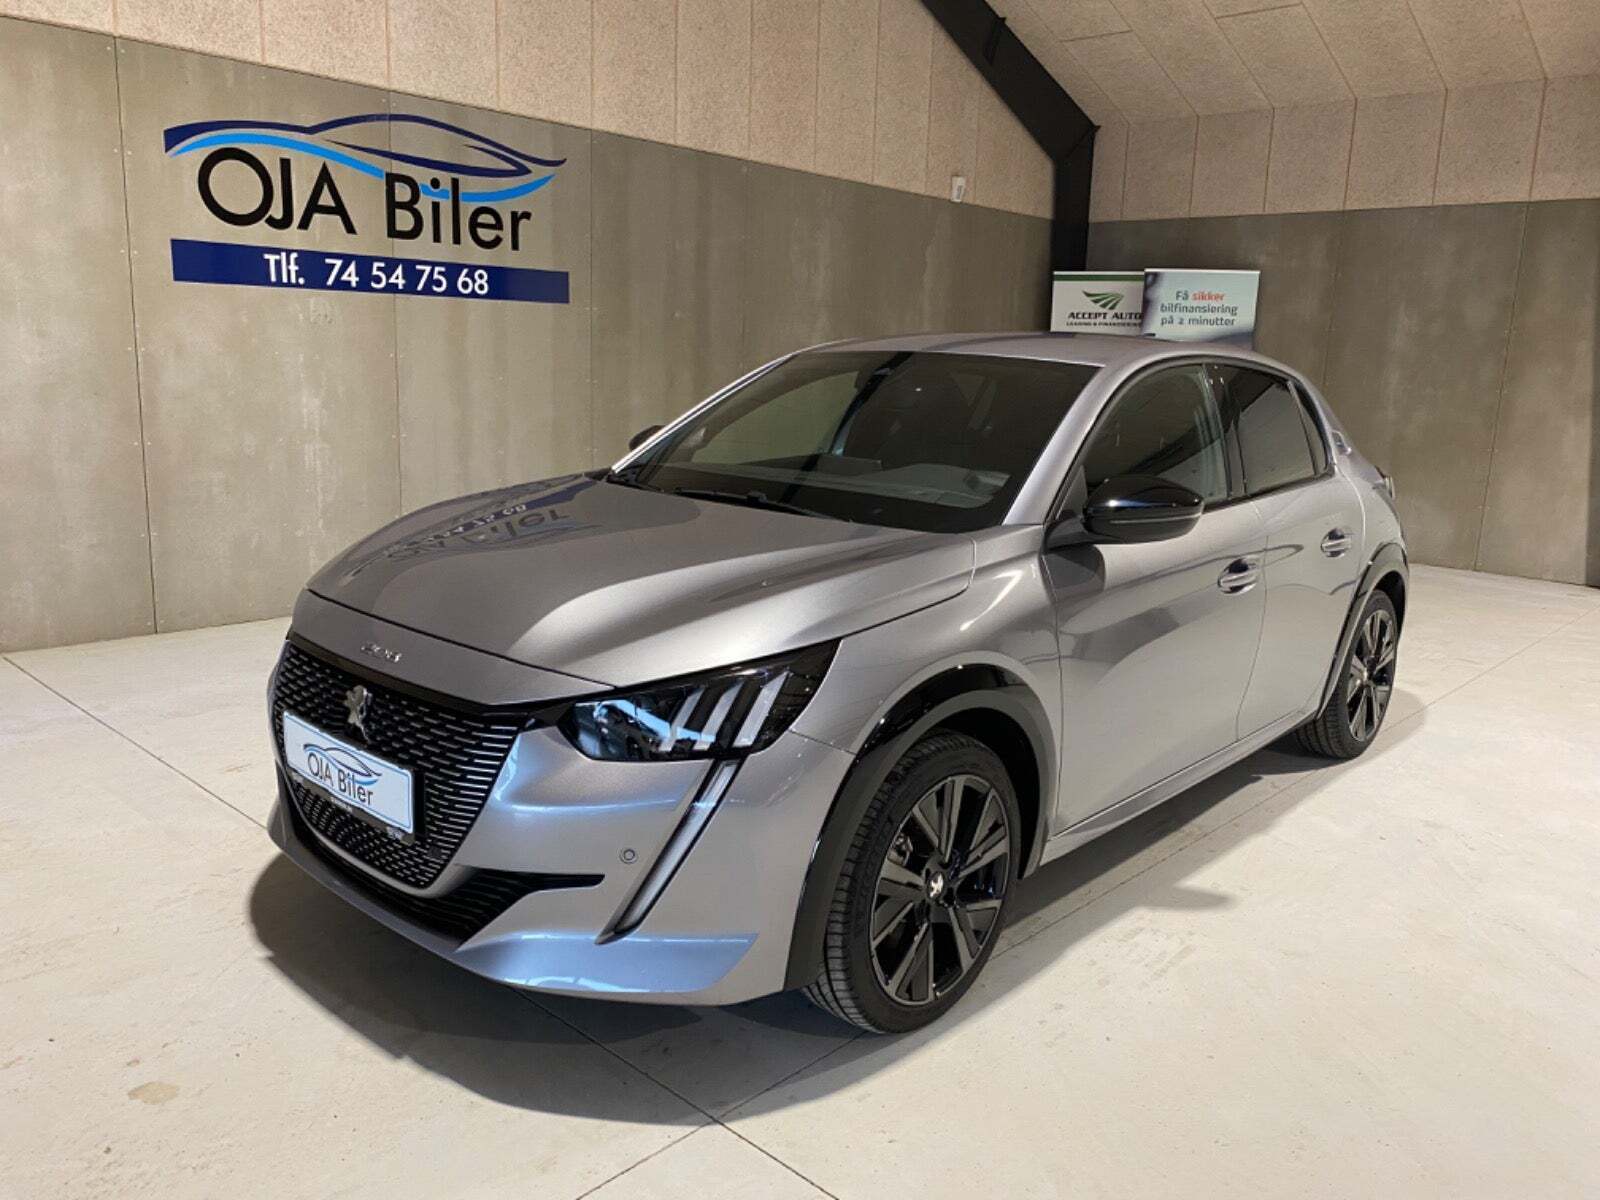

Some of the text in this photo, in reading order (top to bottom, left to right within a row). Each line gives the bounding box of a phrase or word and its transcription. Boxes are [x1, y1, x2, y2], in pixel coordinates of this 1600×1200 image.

[198, 147, 532, 251] OJA Biler
[263, 252, 489, 295] Tlf. 74 54 75 68
[1175, 290, 1225, 301] Få sikker
[1068, 312, 1144, 320] ACCEPT AUTO
[1160, 303, 1238, 316] bilfinansiering
[1161, 315, 1236, 327] på 2 minutter
[307, 752, 334, 787] OJA
[337, 769, 373, 805] Biler
